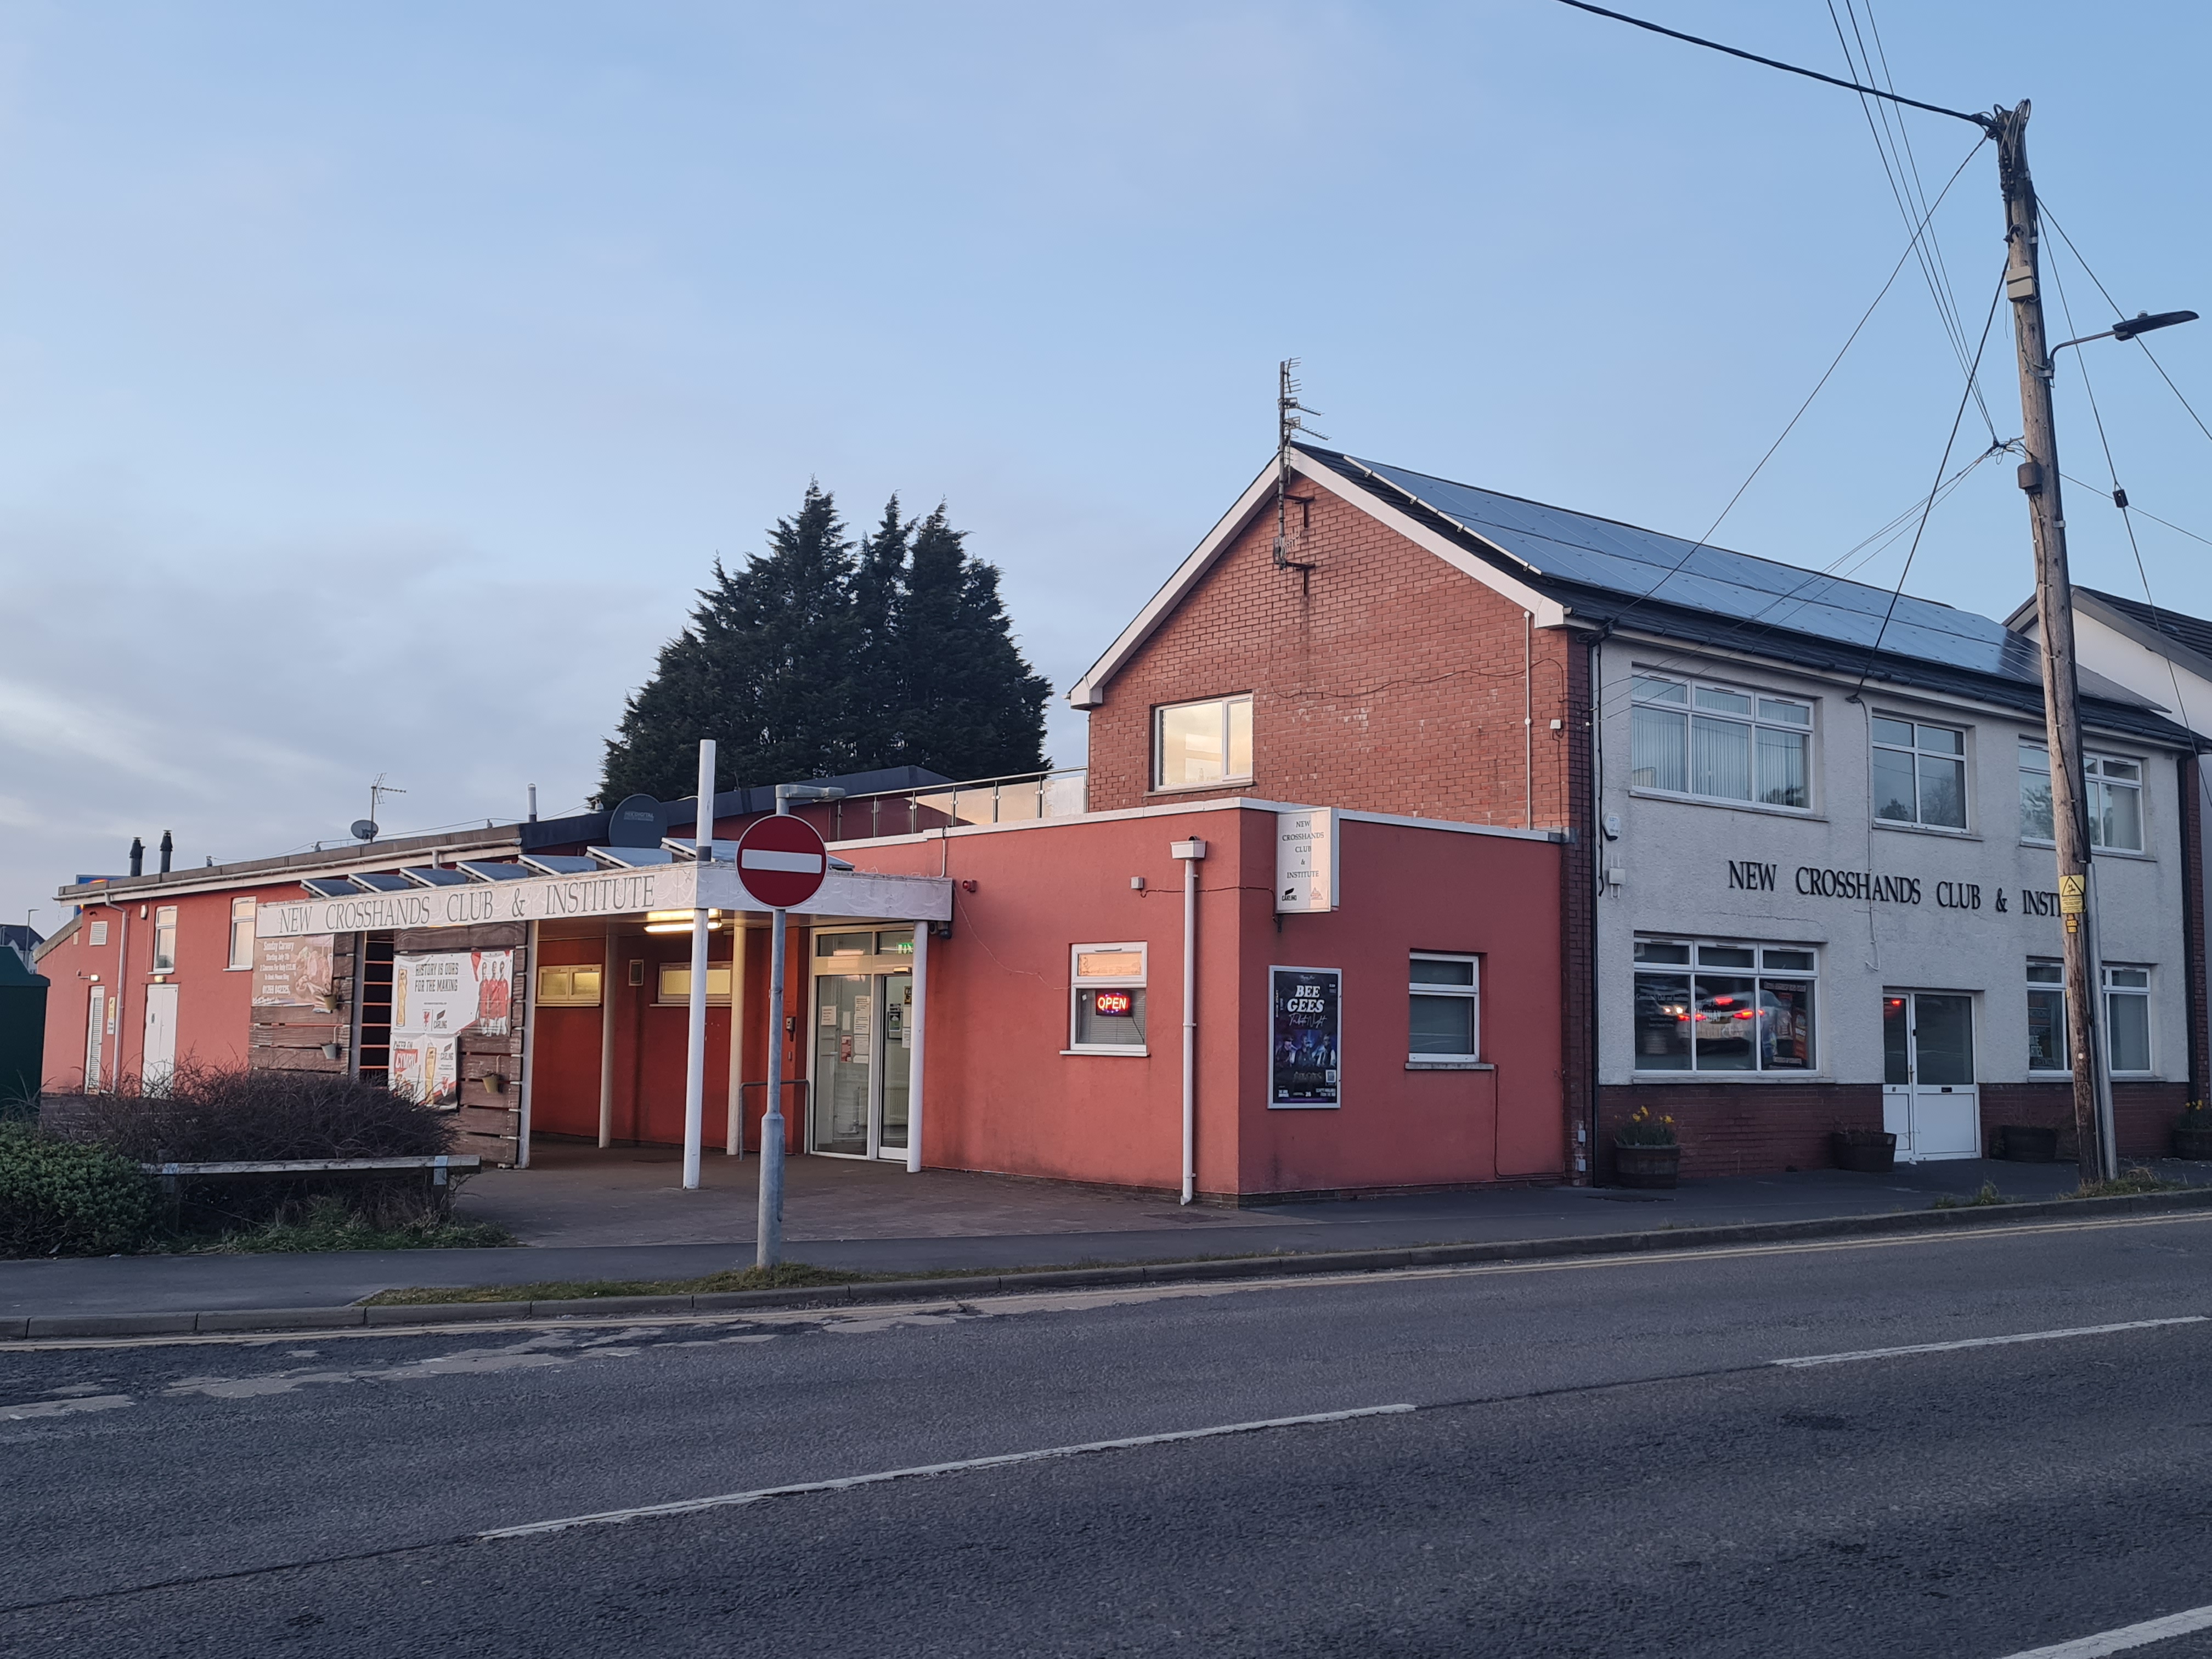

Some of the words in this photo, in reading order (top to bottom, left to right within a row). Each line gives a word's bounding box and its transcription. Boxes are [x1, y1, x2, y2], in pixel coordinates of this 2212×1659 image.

[1282, 832, 1324, 842] CROSSHANDS
[1729, 860, 1777, 891] NEW
[1795, 866, 1921, 905] CROSSHANDS
[1936, 881, 1981, 910] CLUB
[1995, 887, 2008, 913] &
[2022, 889, 2061, 917] INSTI
[279, 906, 313, 933] NEW
[326, 896, 430, 930] CROSSHANDS
[447, 890, 493, 922] CLUB
[511, 887, 526, 917] &
[545, 875, 655, 915] INSTITUTE
[415, 963, 437, 976] HISTORY
[438, 963, 443, 975] IS
[445, 963, 459, 975] OURS
[415, 980, 424, 992] FOR
[426, 979, 436, 992] THE
[437, 979, 458, 992] MAKING
[1295, 985, 1321, 998] BEE
[1098, 997, 1126, 1010] OPEN
[1287, 998, 1325, 1013] GEES
[433, 1020, 447, 1029] CARLING
[396, 1053, 417, 1069] CYMRU
